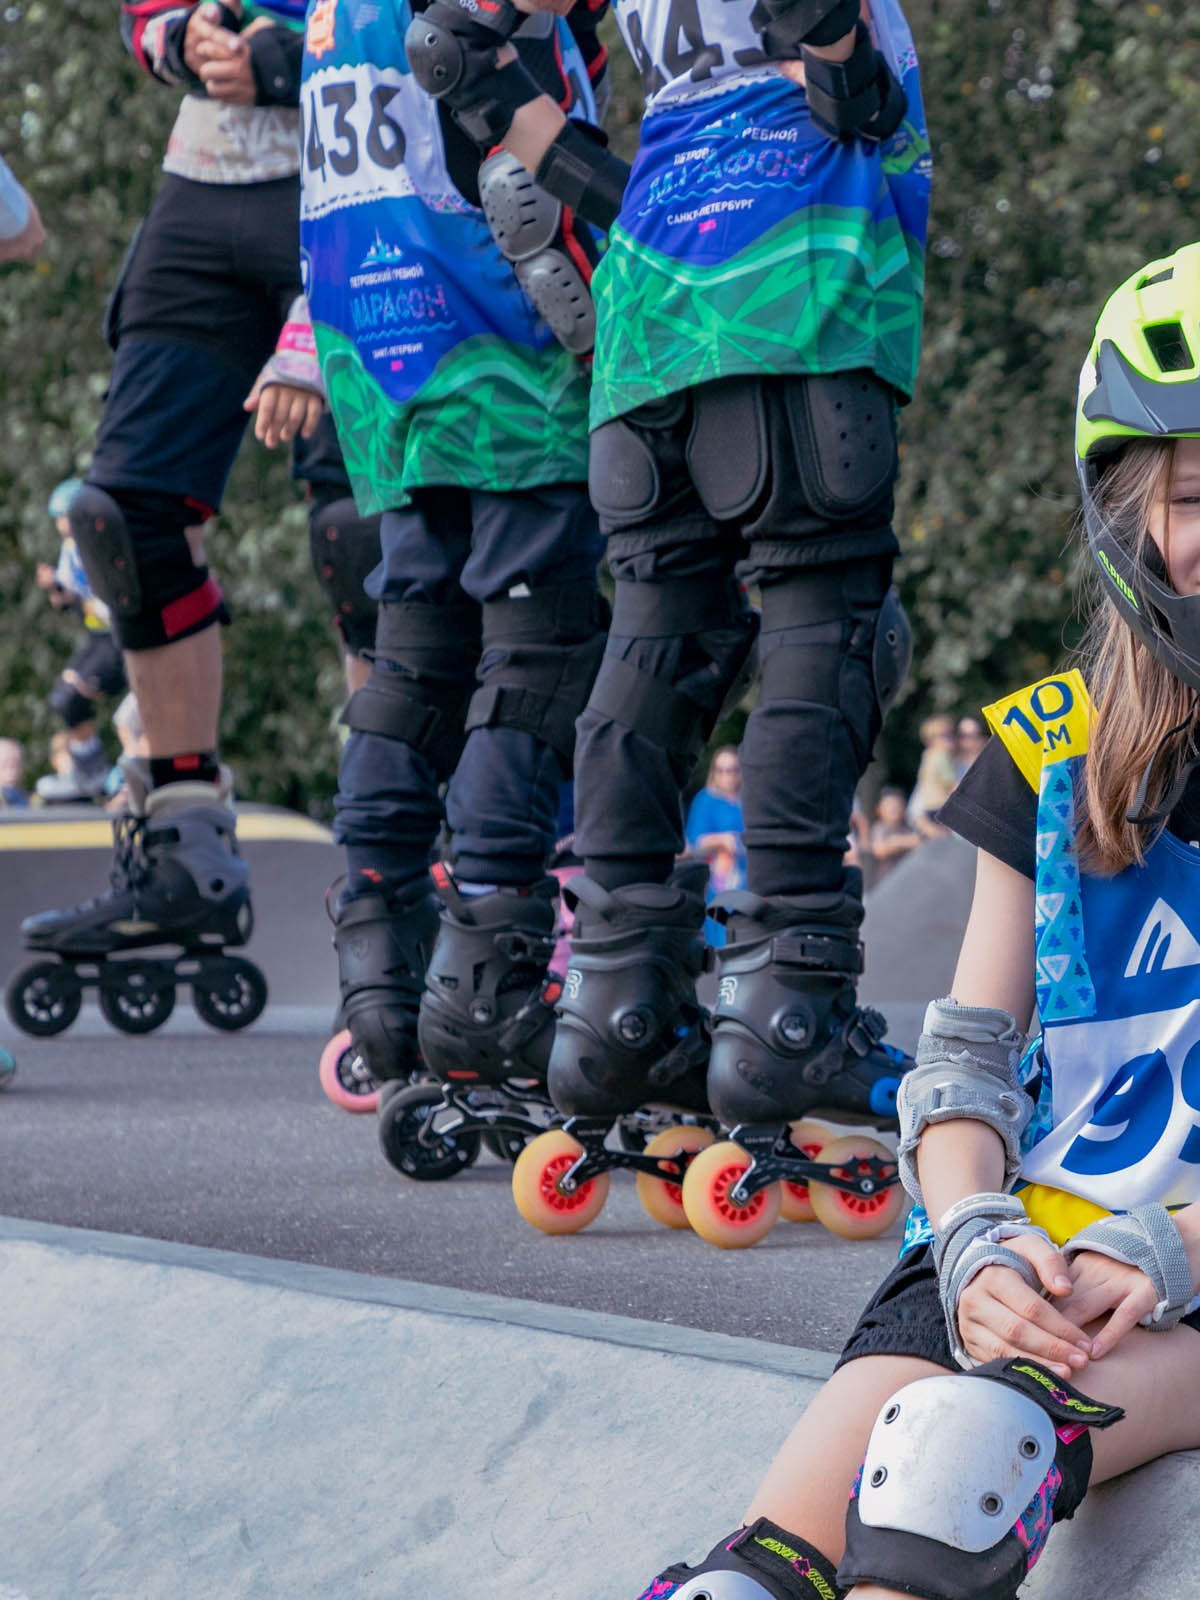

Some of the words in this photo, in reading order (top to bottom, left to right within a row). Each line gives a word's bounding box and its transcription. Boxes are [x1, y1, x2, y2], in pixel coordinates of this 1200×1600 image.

[300, 81, 407, 184] 436
[1097, 550, 1139, 609] ALPINA
[1002, 680, 1074, 744] 10
